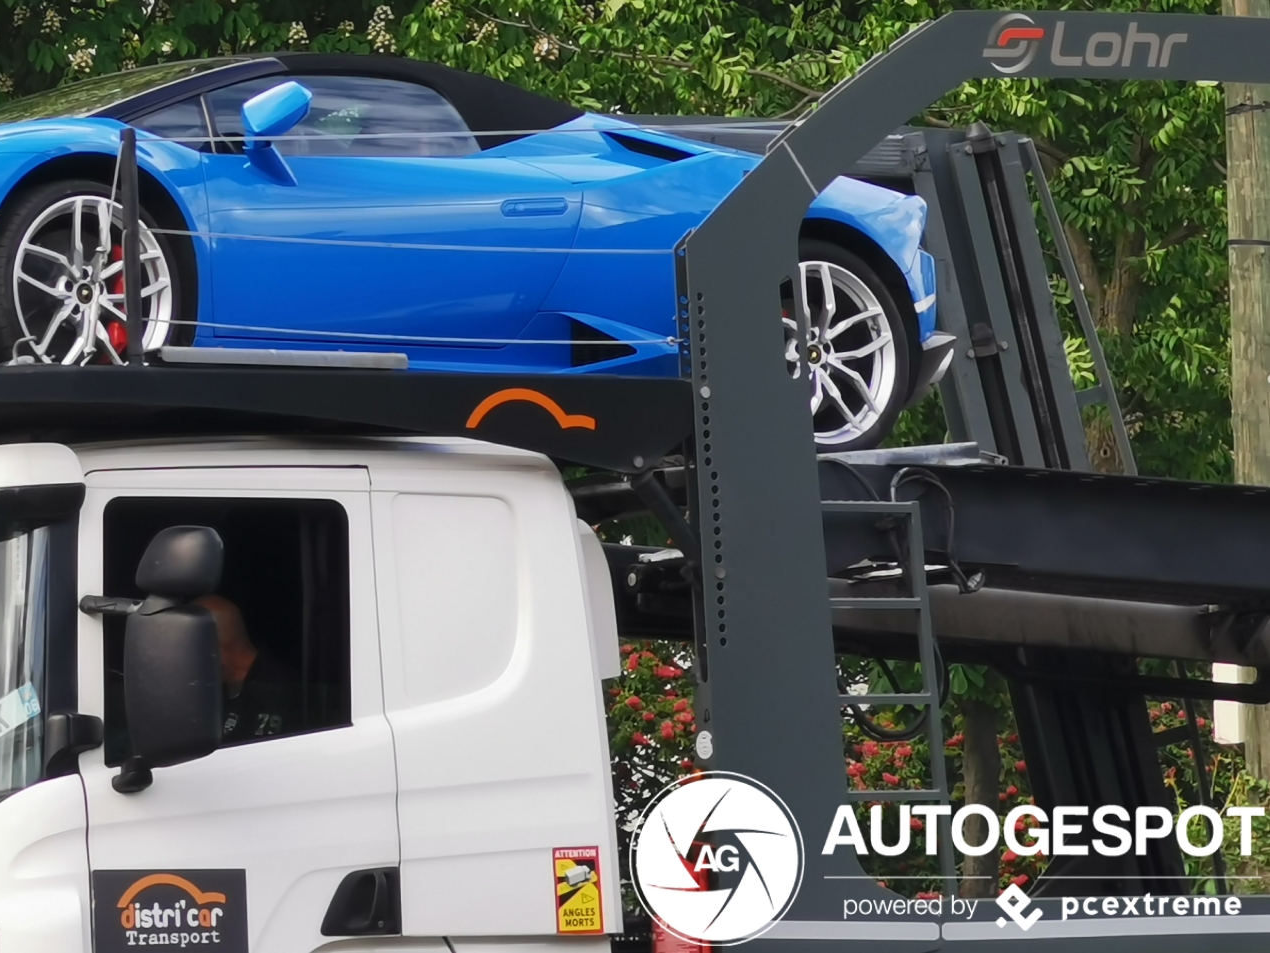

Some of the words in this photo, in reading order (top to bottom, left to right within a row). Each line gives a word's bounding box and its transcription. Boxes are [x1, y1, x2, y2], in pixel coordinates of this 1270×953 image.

[1050, 21, 1189, 68] Lohr
[554, 849, 597, 858] ATTENTION
[120, 899, 224, 929] distri'car
[562, 907, 596, 917] ANGLES
[565, 917, 595, 927] MORTS
[125, 930, 221, 948] Transport
